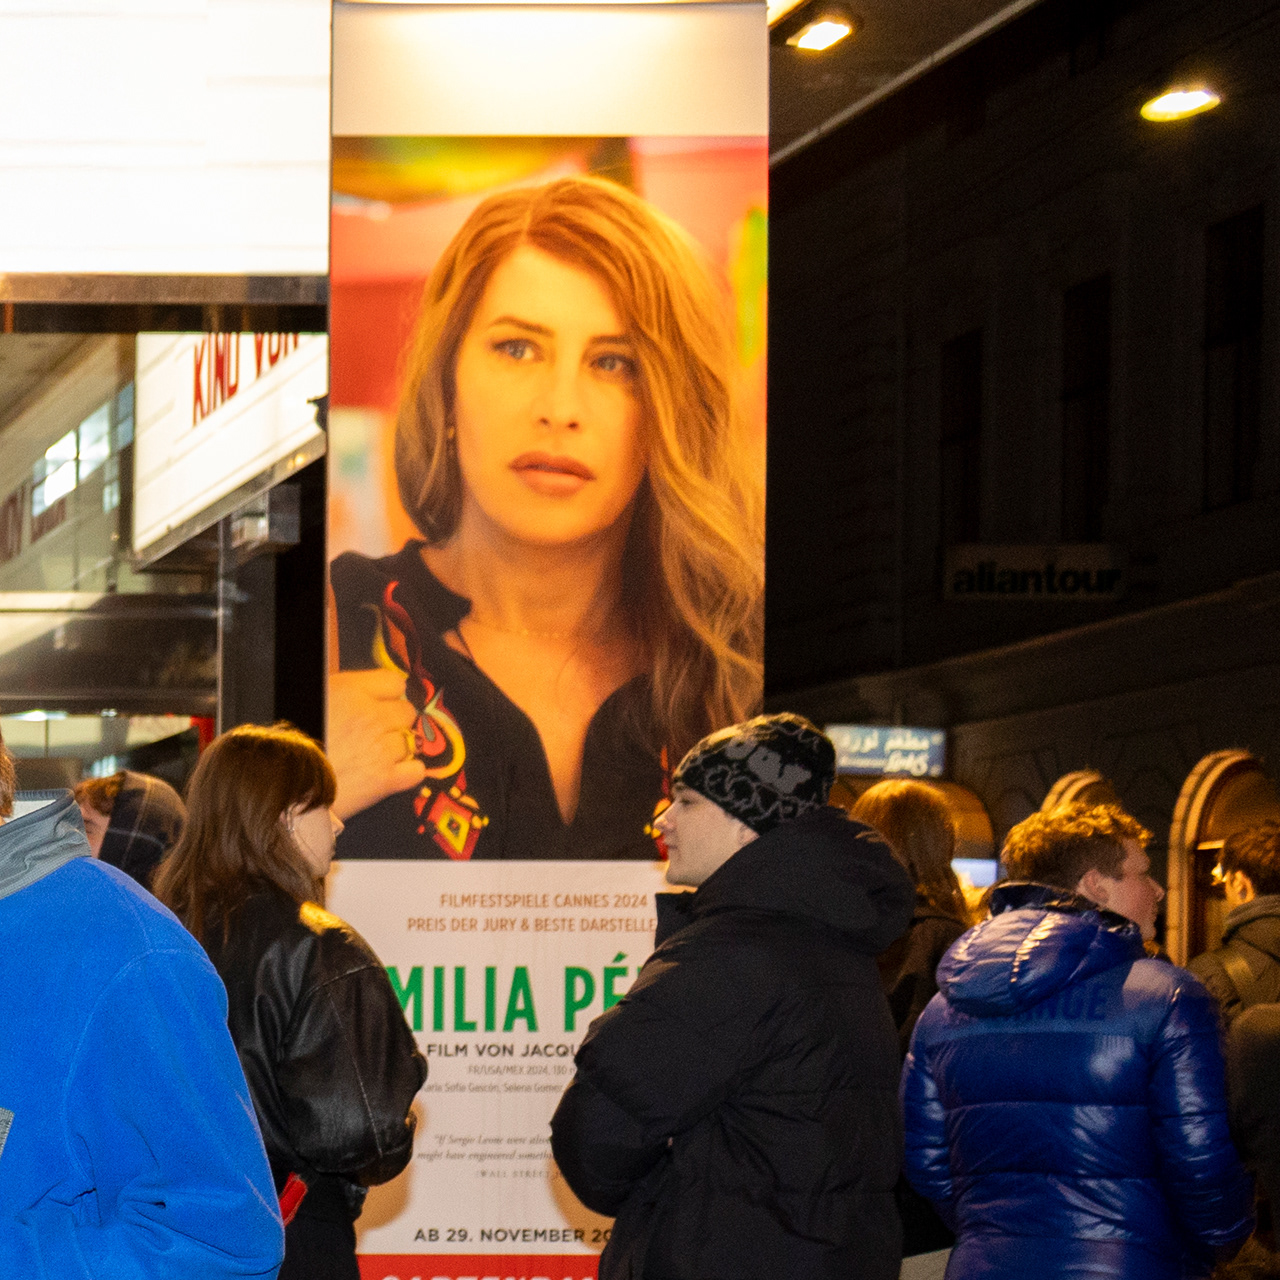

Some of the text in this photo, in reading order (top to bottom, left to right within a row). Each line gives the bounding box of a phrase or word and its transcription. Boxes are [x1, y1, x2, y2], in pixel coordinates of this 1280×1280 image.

[440, 894, 648, 908] FILMFESTSPIELE CANNES 2024
[407, 917, 446, 932] PREIS
[451, 917, 478, 932] DER
[483, 917, 516, 932] JURY
[520, 918, 530, 931] &
[535, 917, 576, 932] BESTE
[563, 951, 645, 1032] PÉ
[426, 1043, 468, 1057] FILM
[475, 1043, 514, 1057] VON
[414, 1229, 439, 1242] AB
[446, 1229, 473, 1242] 29.
[480, 1229, 584, 1242] NOVEMBER
